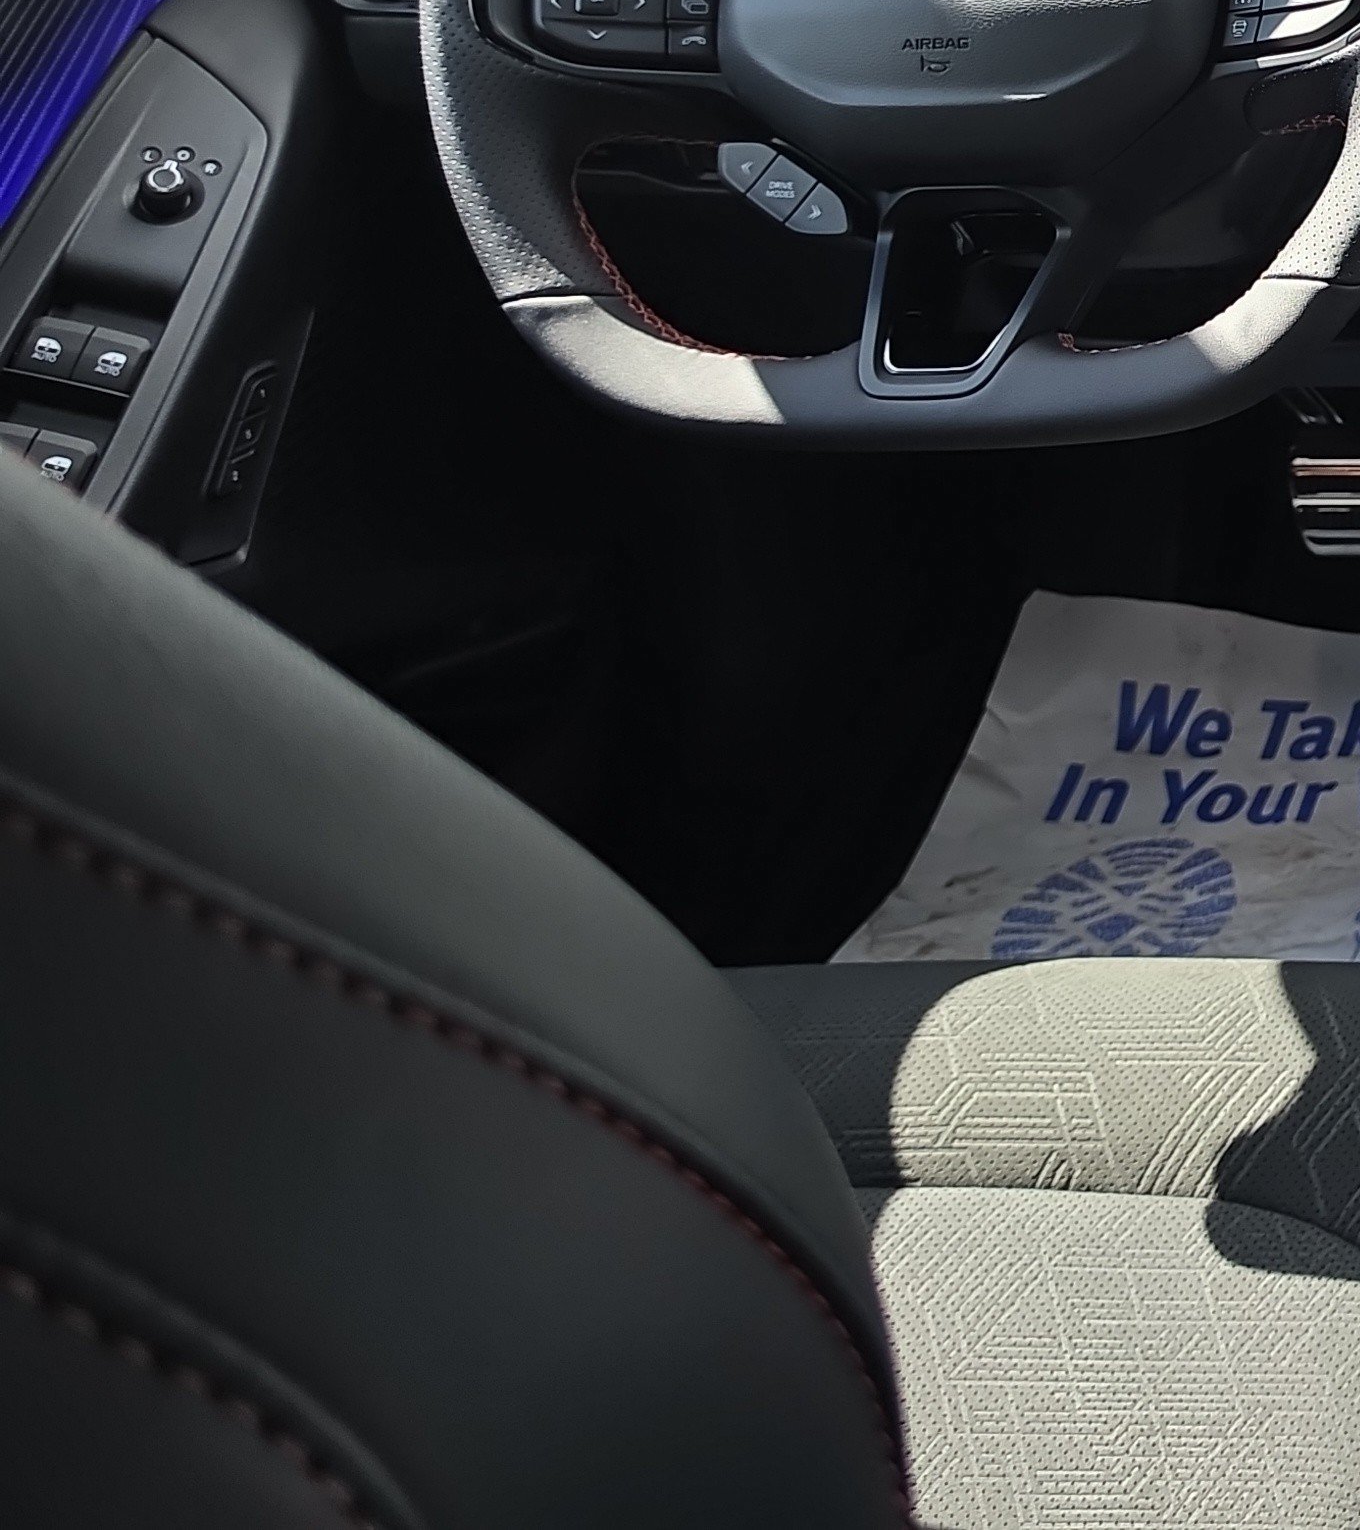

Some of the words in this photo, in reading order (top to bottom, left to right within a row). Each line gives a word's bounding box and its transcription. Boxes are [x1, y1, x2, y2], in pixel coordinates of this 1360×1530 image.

[901, 37, 971, 50] AIRBAG
[144, 149, 154, 162] L
[205, 162, 217, 174] R
[766, 190, 795, 199] MODES
[768, 181, 794, 190] DRIVE
[31, 351, 58, 363] AUTO
[94, 365, 120, 377] AUTO
[1114, 678, 1232, 757] We
[1042, 763, 1129, 825] In
[1160, 768, 1337, 825] Your
